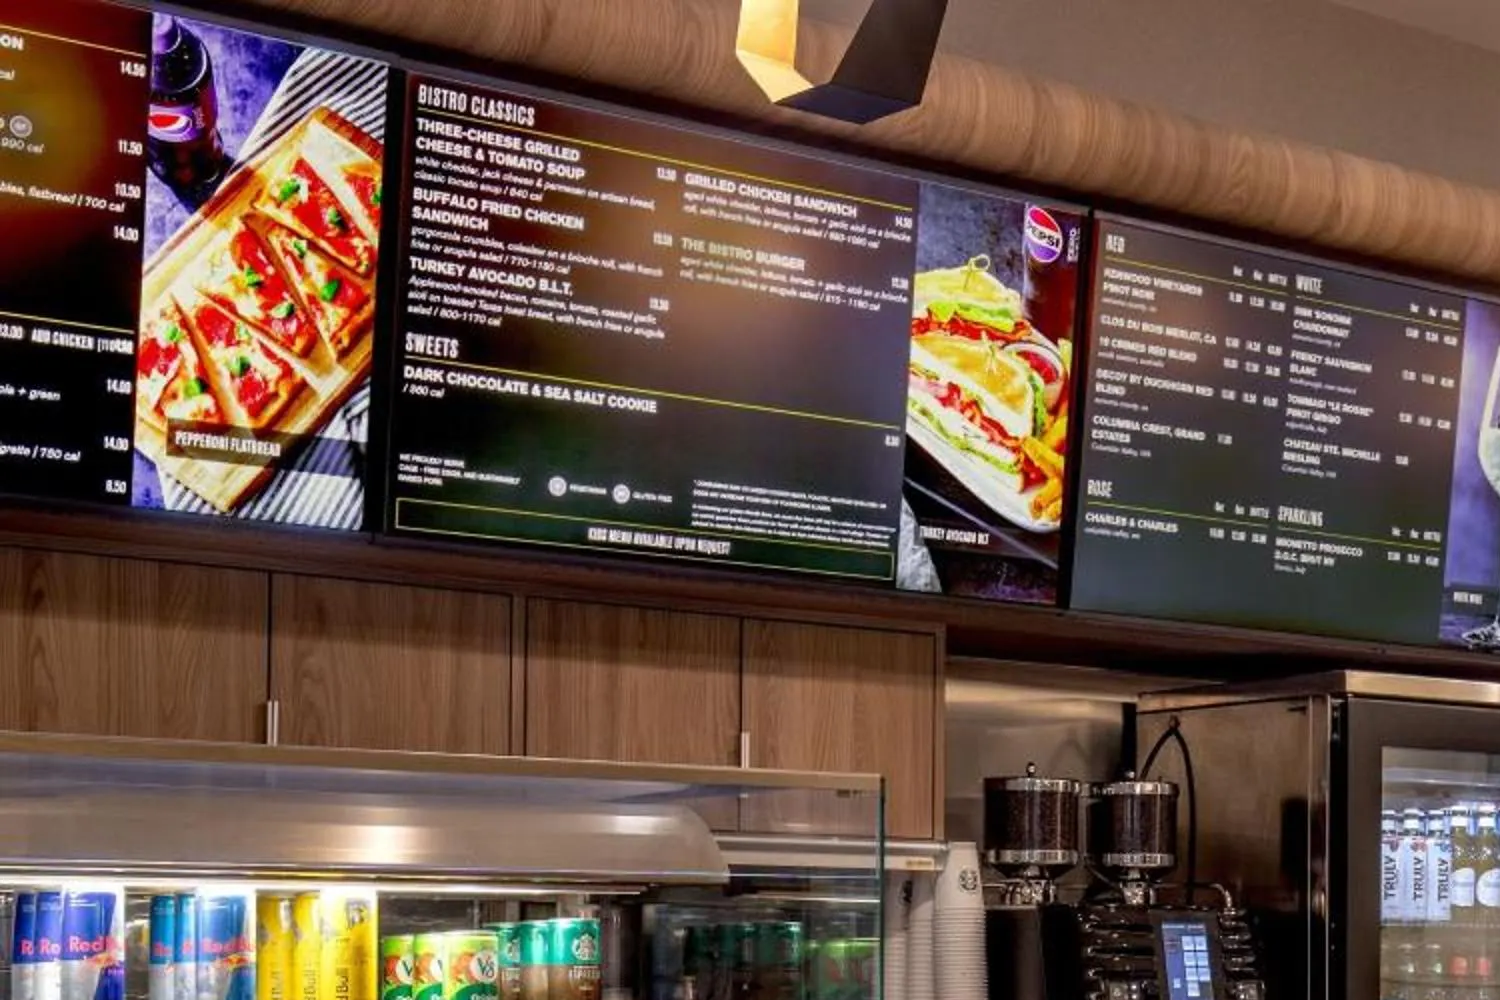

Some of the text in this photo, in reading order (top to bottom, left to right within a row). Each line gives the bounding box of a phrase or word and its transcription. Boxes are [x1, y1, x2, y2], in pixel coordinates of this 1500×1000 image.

[418, 84, 535, 128] BISTRO CLASSICS
[416, 135, 585, 182] CHEESE & TOMATO SOUP
[417, 117, 580, 162] THREE-CHEESE GRILLED
[413, 186, 584, 232] BUFFALO FRIED CHICKEN
[685, 172, 857, 218] GRILLED CHICKEN SANDWICH
[412, 205, 488, 231] SANDWICH
[410, 255, 466, 278] TURKEY
[469, 266, 536, 290] AVOCADO
[682, 236, 705, 252] THE
[709, 242, 752, 261] BISTRO
[756, 251, 805, 271] BURGER
[1101, 314, 1124, 328] CLOS
[405, 332, 459, 359] SWEETS
[404, 365, 657, 413] DARK CHOCOLATE & SEA SALT COOKIE
[175, 429, 281, 457] PEPPERONI FLATBREAD
[1085, 512, 1127, 527] CHARLES
[1137, 518, 1178, 533] CHARLES
[1384, 855, 1397, 899] TRULY
[1413, 857, 1425, 901] TRULY
[1438, 858, 1450, 901] TRULY
